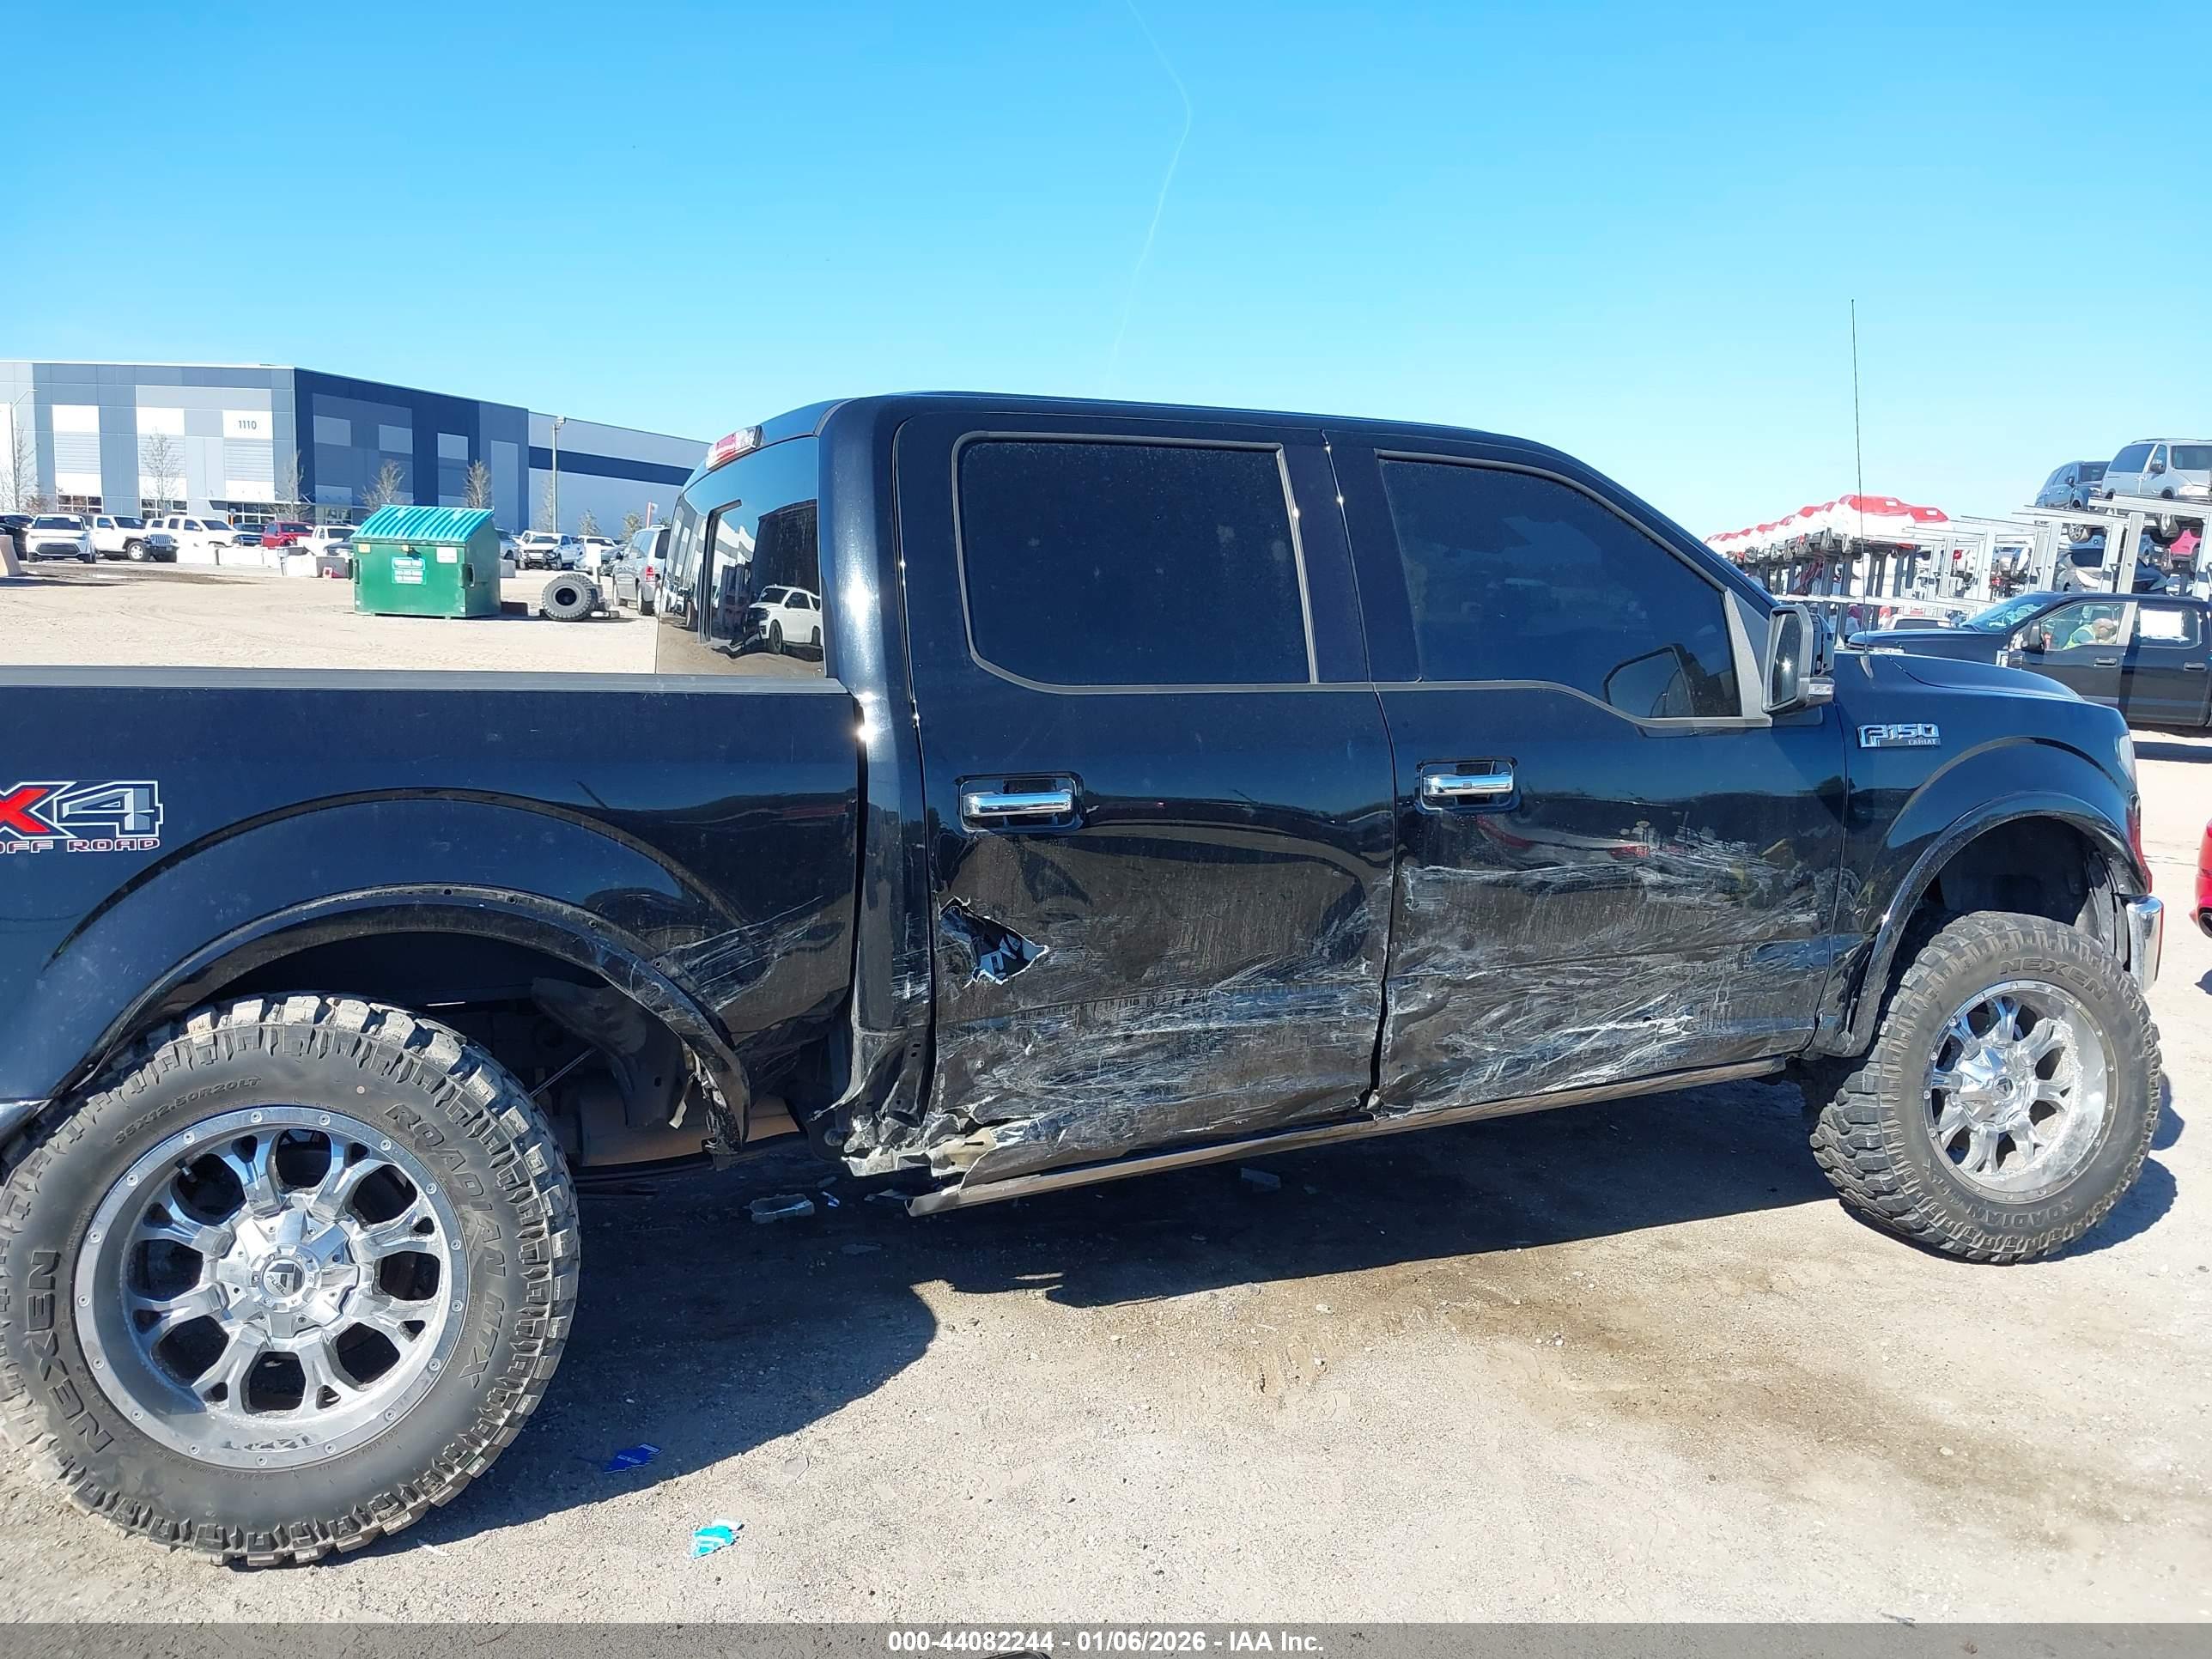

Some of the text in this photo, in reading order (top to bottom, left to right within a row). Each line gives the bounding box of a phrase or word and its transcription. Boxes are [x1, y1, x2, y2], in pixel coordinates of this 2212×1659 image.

[238, 420, 257, 430] 1110
[0, 838, 160, 854] FF ROAD
[1999, 957, 2108, 1001] NEXEN
[385, 1103, 507, 1389] ROADIAN MTX
[266, 1274, 286, 1296] FUEL
[27, 1250, 115, 1454] NEXEN
